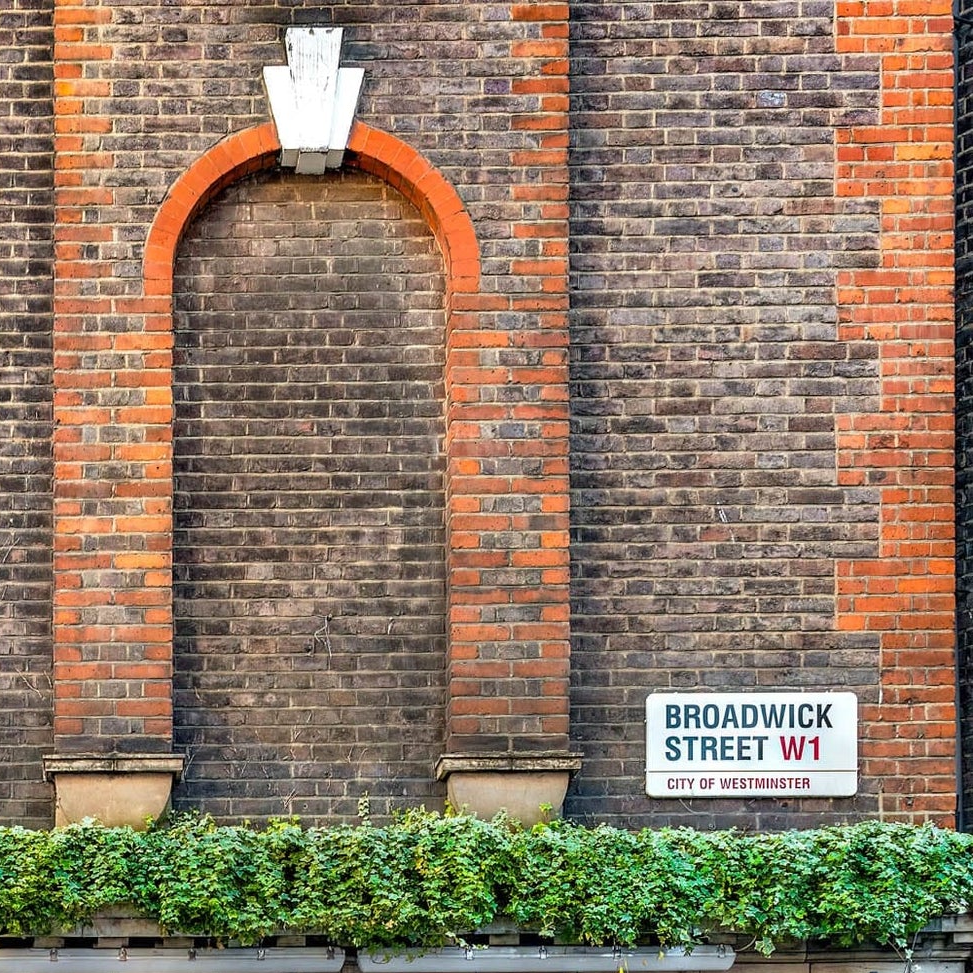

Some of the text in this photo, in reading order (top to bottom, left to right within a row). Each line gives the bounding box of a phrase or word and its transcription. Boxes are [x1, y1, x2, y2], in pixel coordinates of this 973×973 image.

[665, 703, 833, 729] BROADWICK
[665, 735, 820, 761] STREET W1
[667, 777, 810, 790] CITY OF WESTMINSTER
